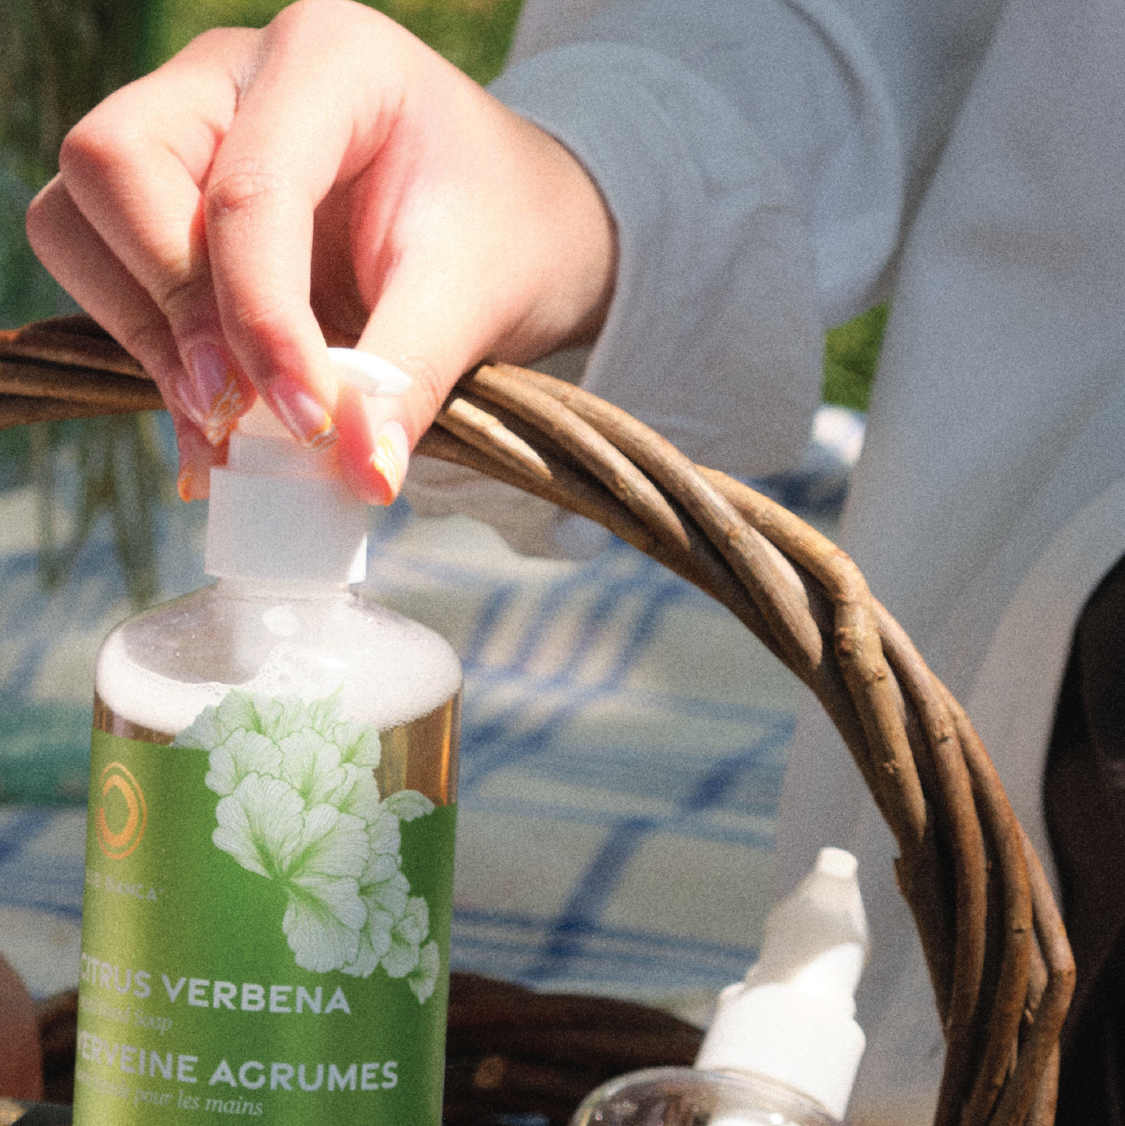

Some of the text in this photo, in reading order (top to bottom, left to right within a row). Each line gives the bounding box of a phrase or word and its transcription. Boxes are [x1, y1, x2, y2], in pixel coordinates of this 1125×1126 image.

[161, 973, 352, 1015] VERBENA
[208, 1060, 399, 1092] AGRUMES
[177, 1089, 200, 1110] les
[205, 1096, 263, 1116] mains
